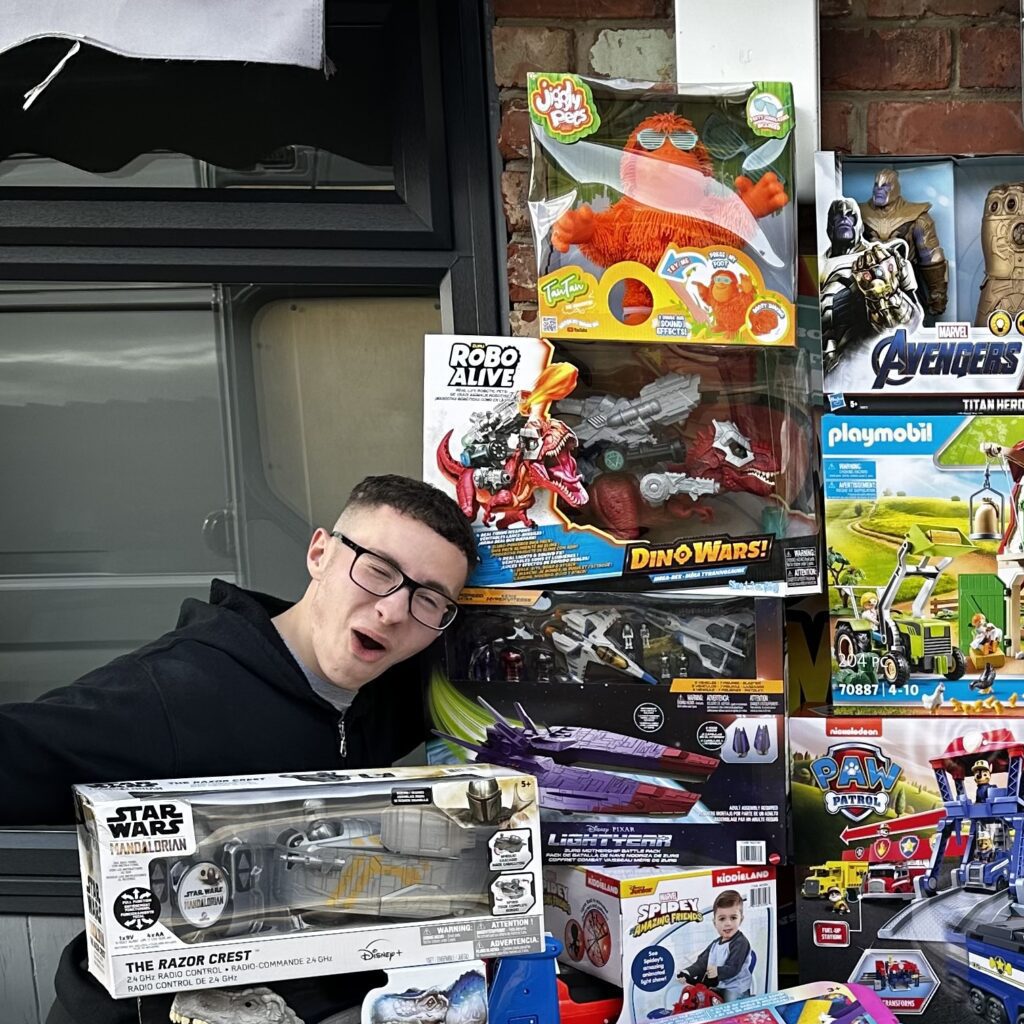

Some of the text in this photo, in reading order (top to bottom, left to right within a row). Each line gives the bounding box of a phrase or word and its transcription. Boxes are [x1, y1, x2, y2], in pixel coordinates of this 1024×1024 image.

[938, 325, 968, 339] MARVEL
[449, 344, 520, 368] ROBO
[872, 330, 1022, 389] AVENGERS
[448, 367, 515, 388] ALIVE
[962, 399, 997, 411] TITAN
[998, 399, 1024, 411] HERO
[828, 422, 933, 447] playmobil
[631, 540, 769, 571] DINO WARS!
[839, 654, 867, 668] 204
[839, 684, 919, 696] 70887 4-10
[830, 727, 878, 736] nickelodeon
[810, 756, 903, 792] PAW
[521, 780, 532, 788] 5+
[832, 796, 881, 807] PATROL
[106, 804, 183, 823] STAR
[107, 819, 184, 839] WARS
[110, 838, 187, 856] MANDALORIAN
[637, 897, 699, 922] SPIDEY
[491, 920, 529, 929] ATTENTION
[671, 911, 703, 925] FRIENDS
[437, 926, 473, 934] WARNING:
[490, 937, 539, 948] ADVERTENCIA:
[126, 950, 252, 974] THE RAZOR CREST
[158, 957, 304, 980] RADIO CONTROL RADIO-COMMANDE
[127, 979, 194, 992] RADIO CONTROL
